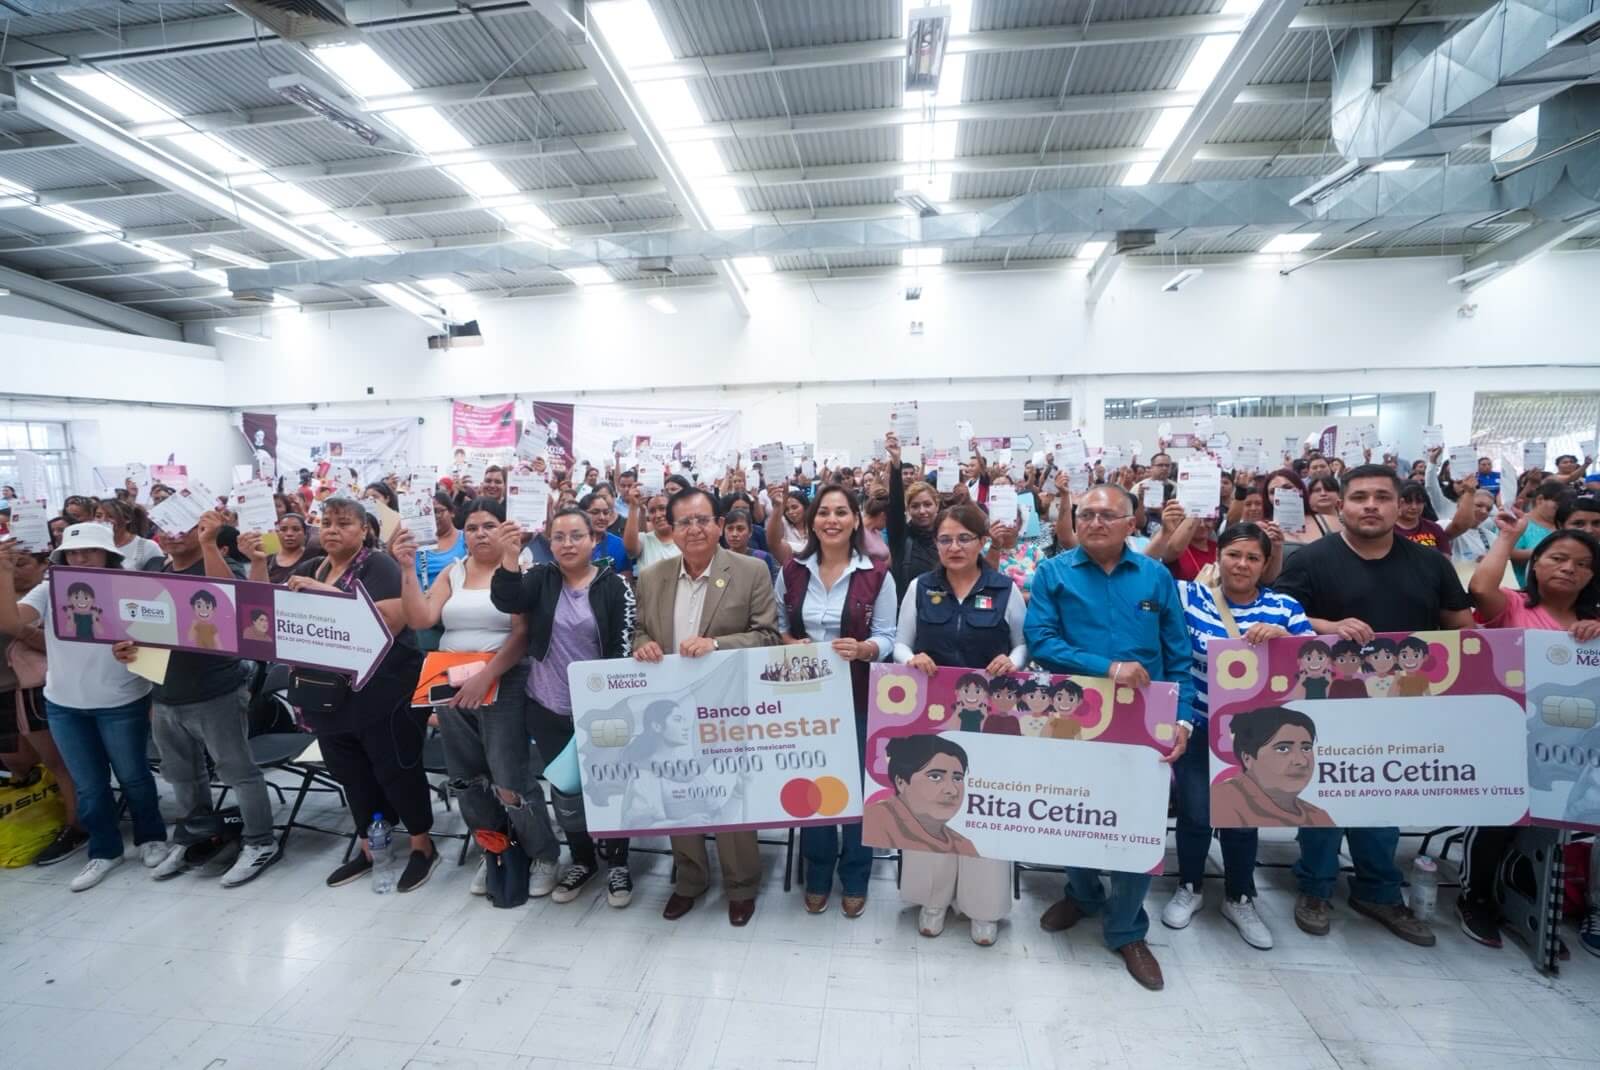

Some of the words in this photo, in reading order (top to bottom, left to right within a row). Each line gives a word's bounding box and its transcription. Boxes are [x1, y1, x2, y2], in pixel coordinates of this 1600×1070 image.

[140, 605, 165, 616] Becas
[276, 618, 304, 635] Rita
[306, 623, 350, 641] Cetina
[1576, 654, 1600, 667] Mé
[606, 672, 638, 680] Gobierno
[638, 671, 647, 679] de
[607, 679, 648, 690] México
[696, 706, 751, 719] Banco
[755, 700, 782, 715] del
[698, 717, 841, 744] Bienestar
[710, 746, 733, 754] banco
[757, 743, 796, 751] mexicanos
[1317, 744, 1384, 756] Educación
[1387, 743, 1445, 755] Primaria
[712, 754, 763, 774] 0000
[775, 749, 827, 770] 0000
[1318, 761, 1376, 783] Rita
[1382, 758, 1476, 783] Cetina
[967, 776, 1032, 793] Educación
[1035, 783, 1091, 798] Primaria
[1318, 789, 1342, 797] BECA
[1344, 789, 1357, 797] DE
[1358, 789, 1392, 797] APOYO
[1394, 788, 1420, 797] PARA
[1422, 787, 1480, 797] UNIFORMES
[1482, 787, 1489, 795] Y
[1490, 785, 1525, 795] ÚTILES
[966, 793, 1021, 819] Rita
[1028, 798, 1117, 827] Cetina
[965, 820, 988, 830] BECA
[990, 823, 1001, 831] DE
[1003, 824, 1036, 834] APOYO
[1038, 826, 1062, 837] PARA
[1064, 828, 1119, 841] UNIFORMES
[1120, 834, 1127, 842] Y
[1128, 834, 1161, 845] ÚTILES
